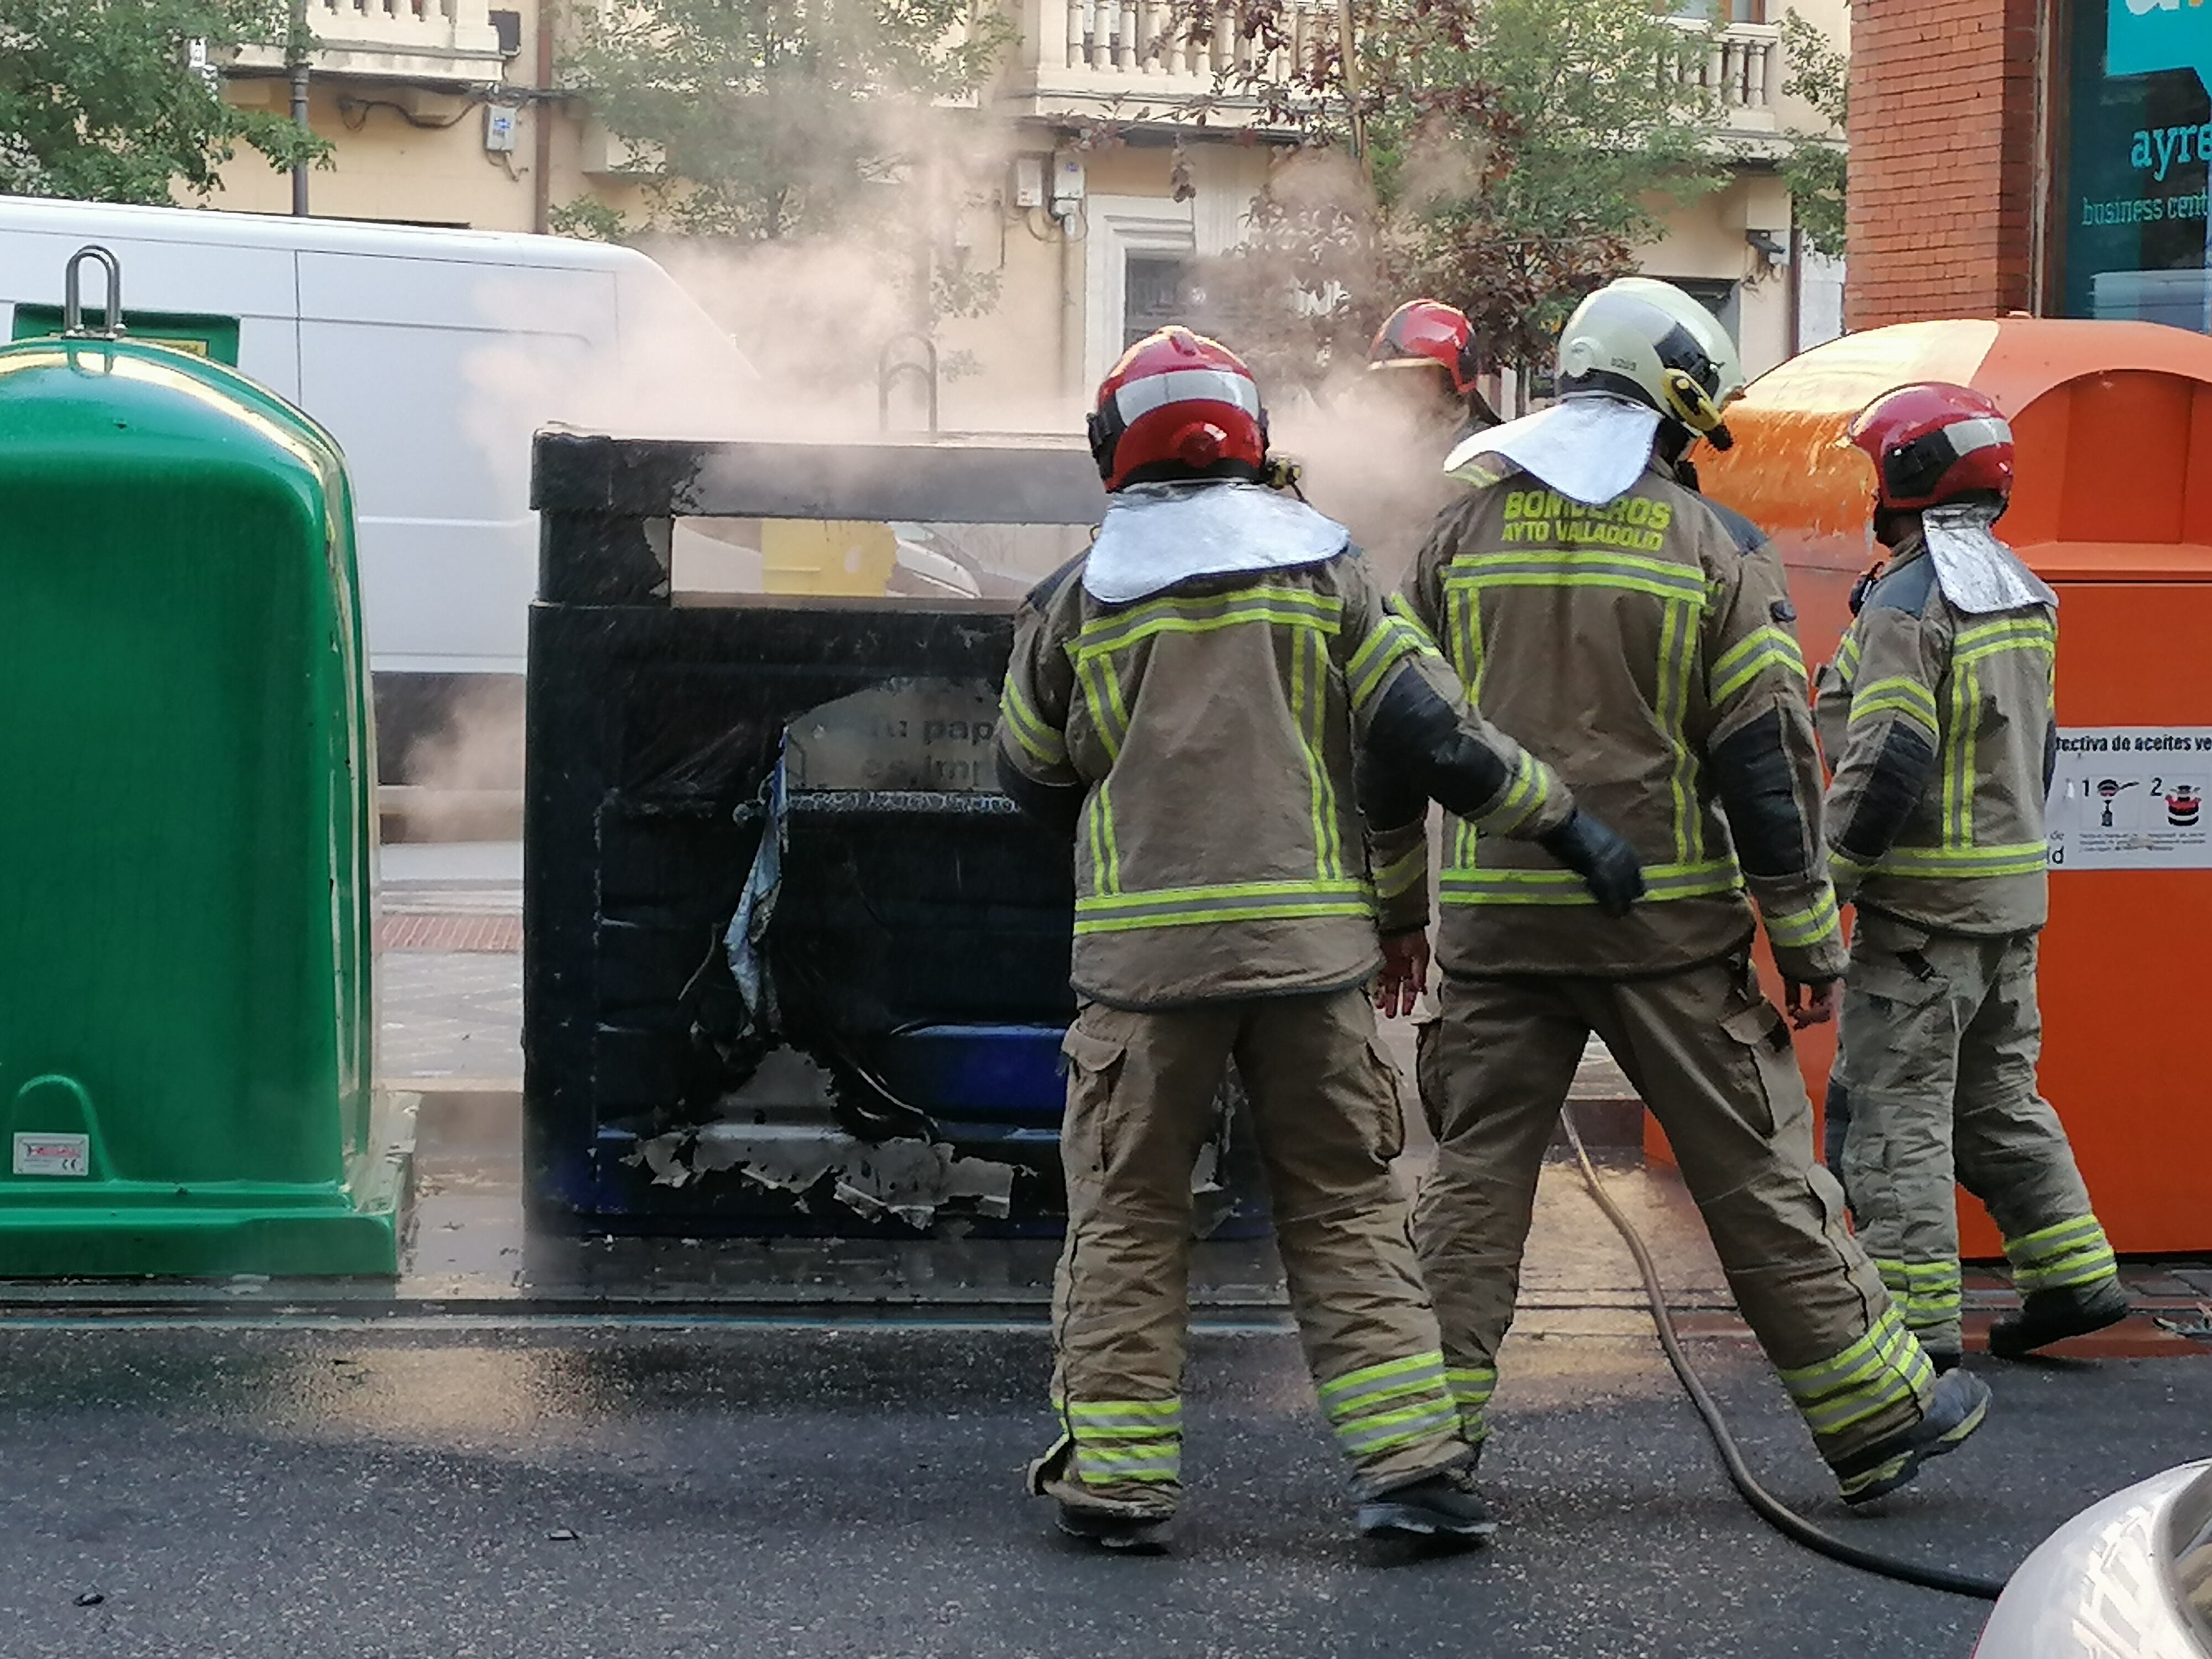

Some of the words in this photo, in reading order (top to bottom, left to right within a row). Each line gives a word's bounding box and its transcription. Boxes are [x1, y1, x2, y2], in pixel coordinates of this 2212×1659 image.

[2082, 197, 2163, 226] business
[1501, 521, 1550, 542] AYTO
[1556, 520, 1663, 551] VALLADOLID
[2112, 734, 2131, 752] de
[2135, 734, 2192, 752] aceites
[2082, 777, 2089, 797] 1
[2150, 777, 2163, 797] 2
